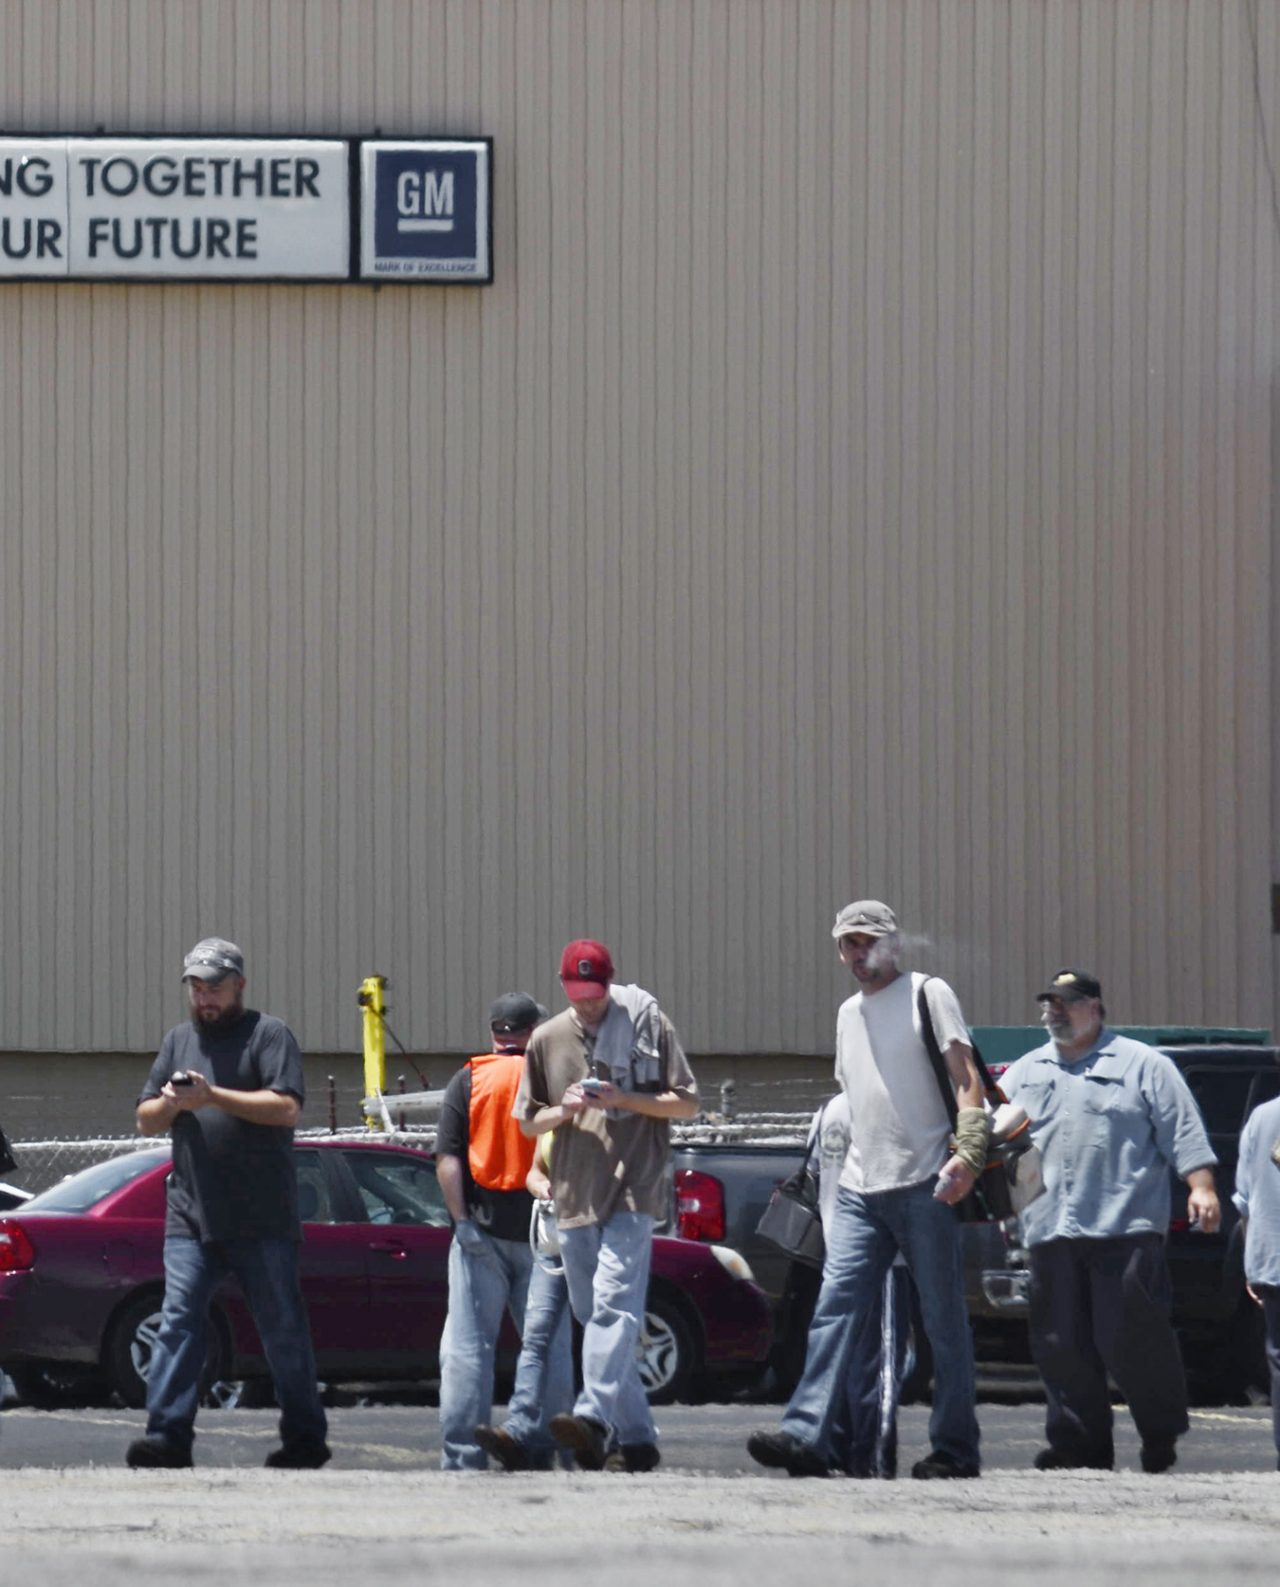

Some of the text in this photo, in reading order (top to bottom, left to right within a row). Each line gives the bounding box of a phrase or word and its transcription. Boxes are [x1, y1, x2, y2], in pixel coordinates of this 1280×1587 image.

[79, 157, 321, 198] TOGETHER
[397, 171, 454, 215] GM
[87, 217, 258, 260] FUTURE
[375, 262, 400, 272] MARK
